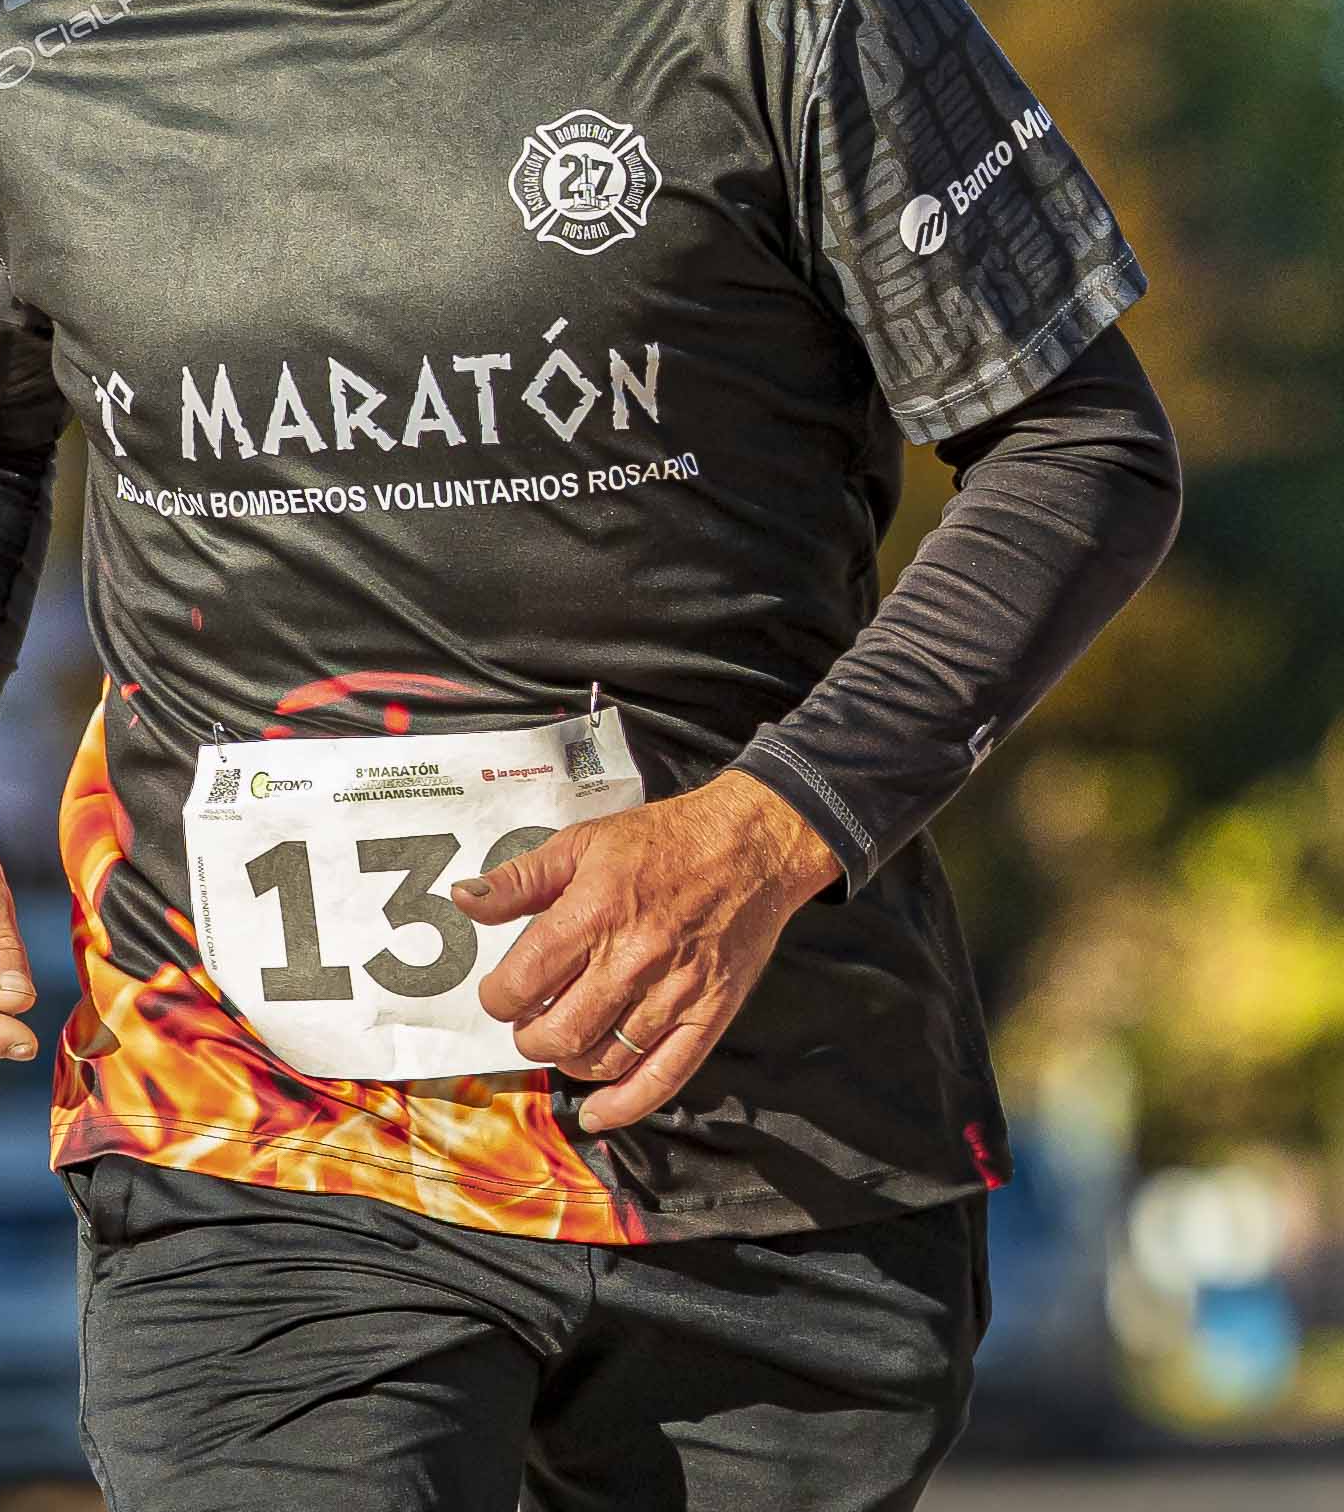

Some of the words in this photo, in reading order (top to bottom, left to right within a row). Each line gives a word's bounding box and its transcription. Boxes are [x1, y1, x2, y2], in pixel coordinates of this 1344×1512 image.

[555, 123, 613, 143] BOMBEROS
[560, 153, 614, 201] 27
[623, 151, 648, 210] VOLUNTARIOS
[947, 140, 1013, 215] Banco
[561, 221, 610, 240] ROSARIO
[181, 316, 660, 462] MARATÓN
[209, 485, 368, 519] BOMBEROS
[373, 472, 580, 511] VOLUNTARIOS
[588, 452, 699, 493] ROSARIO
[344, 775, 452, 790] VERSARIO
